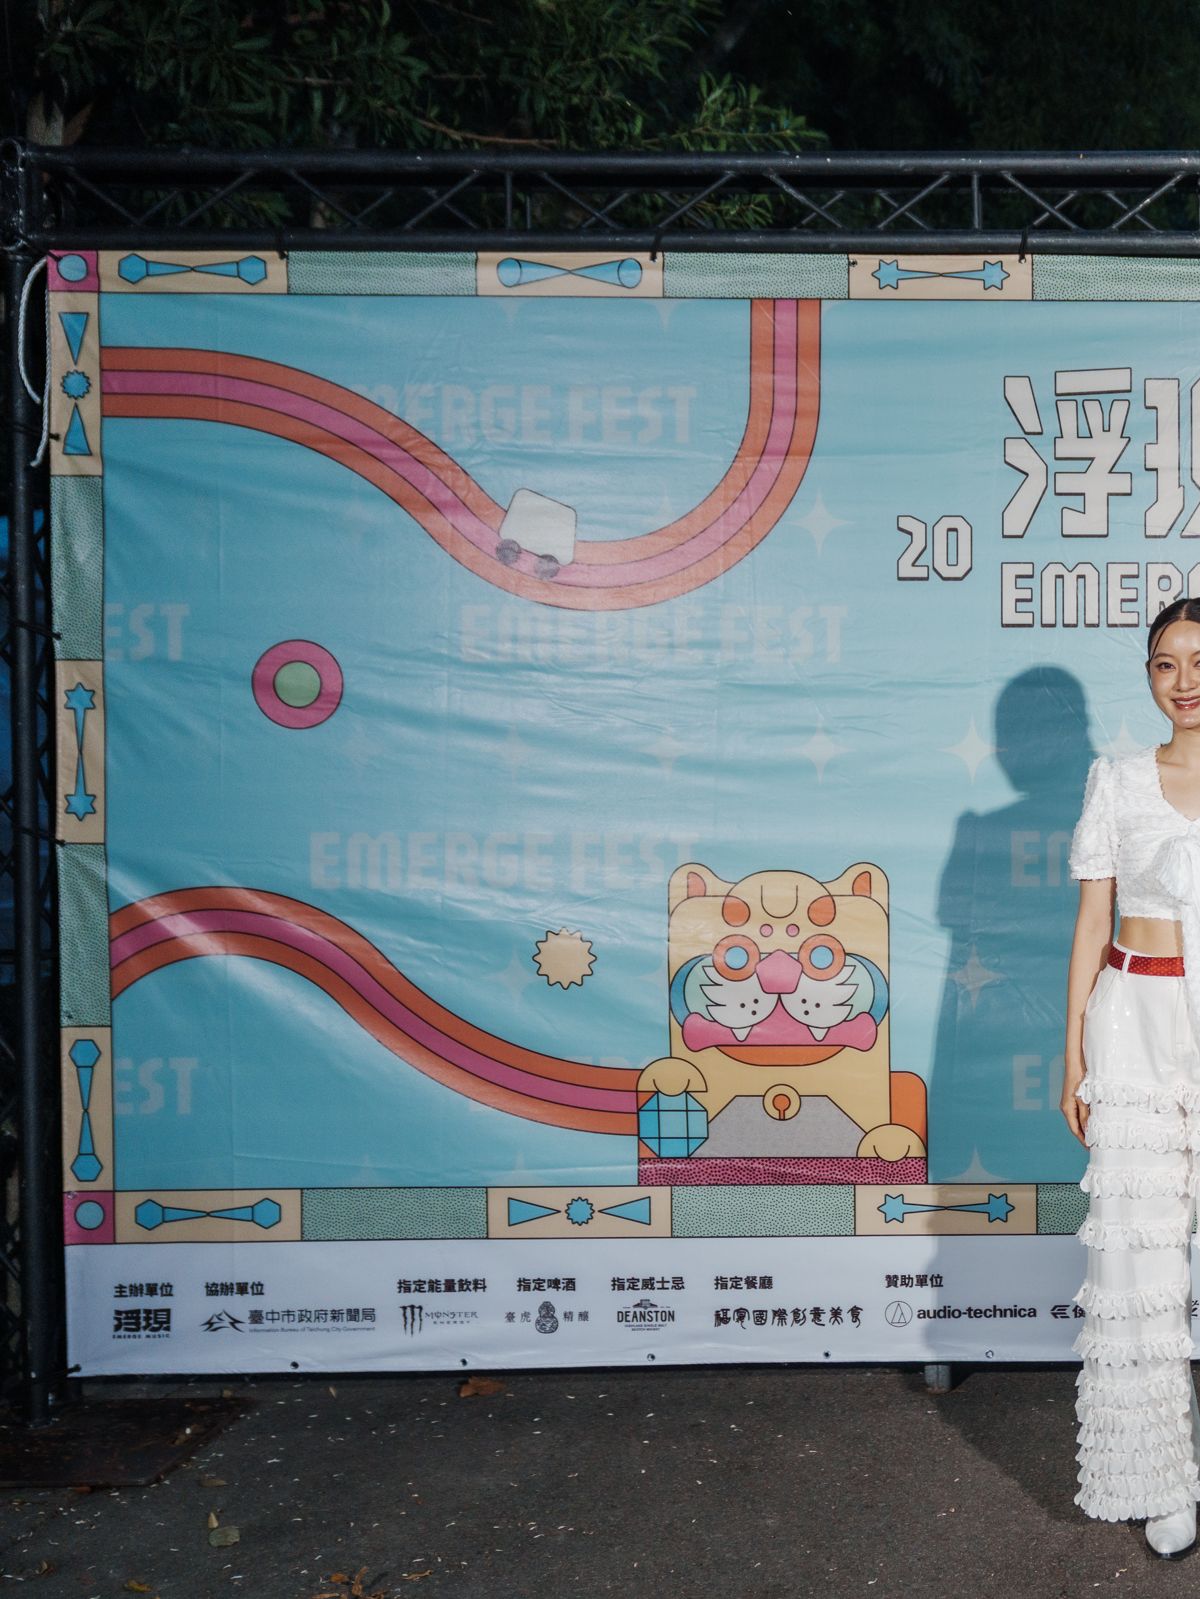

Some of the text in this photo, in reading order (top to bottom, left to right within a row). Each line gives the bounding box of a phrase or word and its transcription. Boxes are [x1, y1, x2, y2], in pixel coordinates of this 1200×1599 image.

[567, 385, 698, 445] FEST
[896, 515, 973, 582] 20
[722, 604, 850, 663] FEST
[309, 830, 701, 890] EMERGE FEST
[204, 1281, 265, 1297] 協辦單位
[397, 1278, 487, 1294] 指定能量飲料
[516, 1277, 576, 1292] 指定啤酒
[610, 1276, 686, 1292] 指定威士忌
[714, 1275, 774, 1290] 指定餐廳
[885, 1274, 944, 1289] 贊助單位
[113, 1282, 174, 1298] 主辦單位
[247, 1307, 376, 1325] 臺中市政府新聞局
[616, 1310, 676, 1323] DEANSTON
[916, 1305, 1037, 1319] audio-technica
[112, 1308, 172, 1333] 浮現
